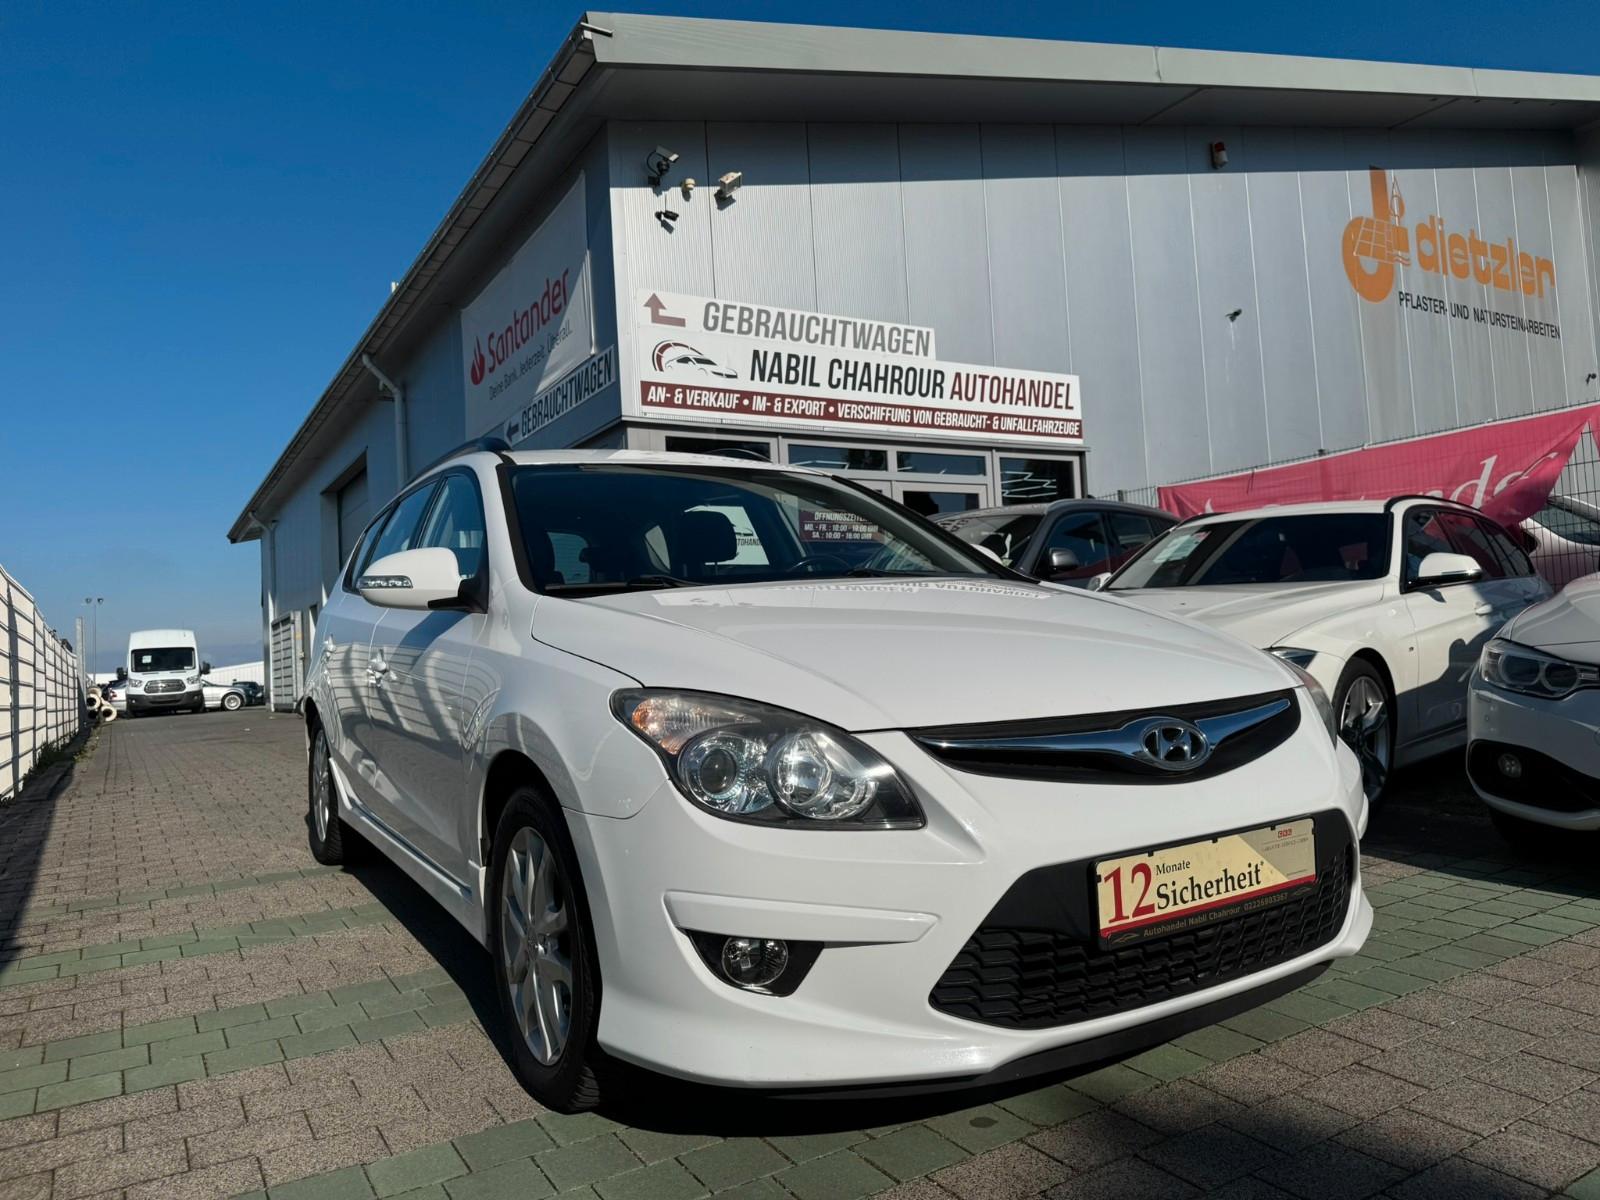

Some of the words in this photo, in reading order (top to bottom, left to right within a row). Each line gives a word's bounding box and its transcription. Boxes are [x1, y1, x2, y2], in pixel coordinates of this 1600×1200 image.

[1416, 216, 1556, 298] dietzler
[488, 268, 570, 374] Santander
[702, 301, 931, 358] GEBRAUCHTWAGEN
[1450, 303, 1470, 320] UND
[1473, 308, 1561, 340] NATURSTEINARBEITEN
[521, 350, 613, 437] GEBRAUCHTWAGEN
[648, 385, 671, 403] AN-
[674, 388, 684, 405] &
[686, 389, 740, 409] VERKAUF
[752, 395, 771, 412] IM-
[774, 397, 783, 414] &
[784, 398, 825, 417] EXPORT
[838, 403, 911, 424] VERSCHIFFUNG
[913, 409, 932, 425] VON
[934, 410, 990, 429] GEBRAUCHT-
[992, 415, 999, 430] &
[1000, 416, 1080, 436] UNFALLFAHRZEUGE
[750, 349, 820, 388] NABIL
[828, 359, 944, 400] CHAHROUR
[950, 372, 1075, 411] AUTOHANDEL
[1104, 862, 1156, 924] 12
[1156, 860, 1191, 876] Monate
[1144, 919, 1187, 938] Autohandel
[1188, 912, 1208, 926] Nabil
